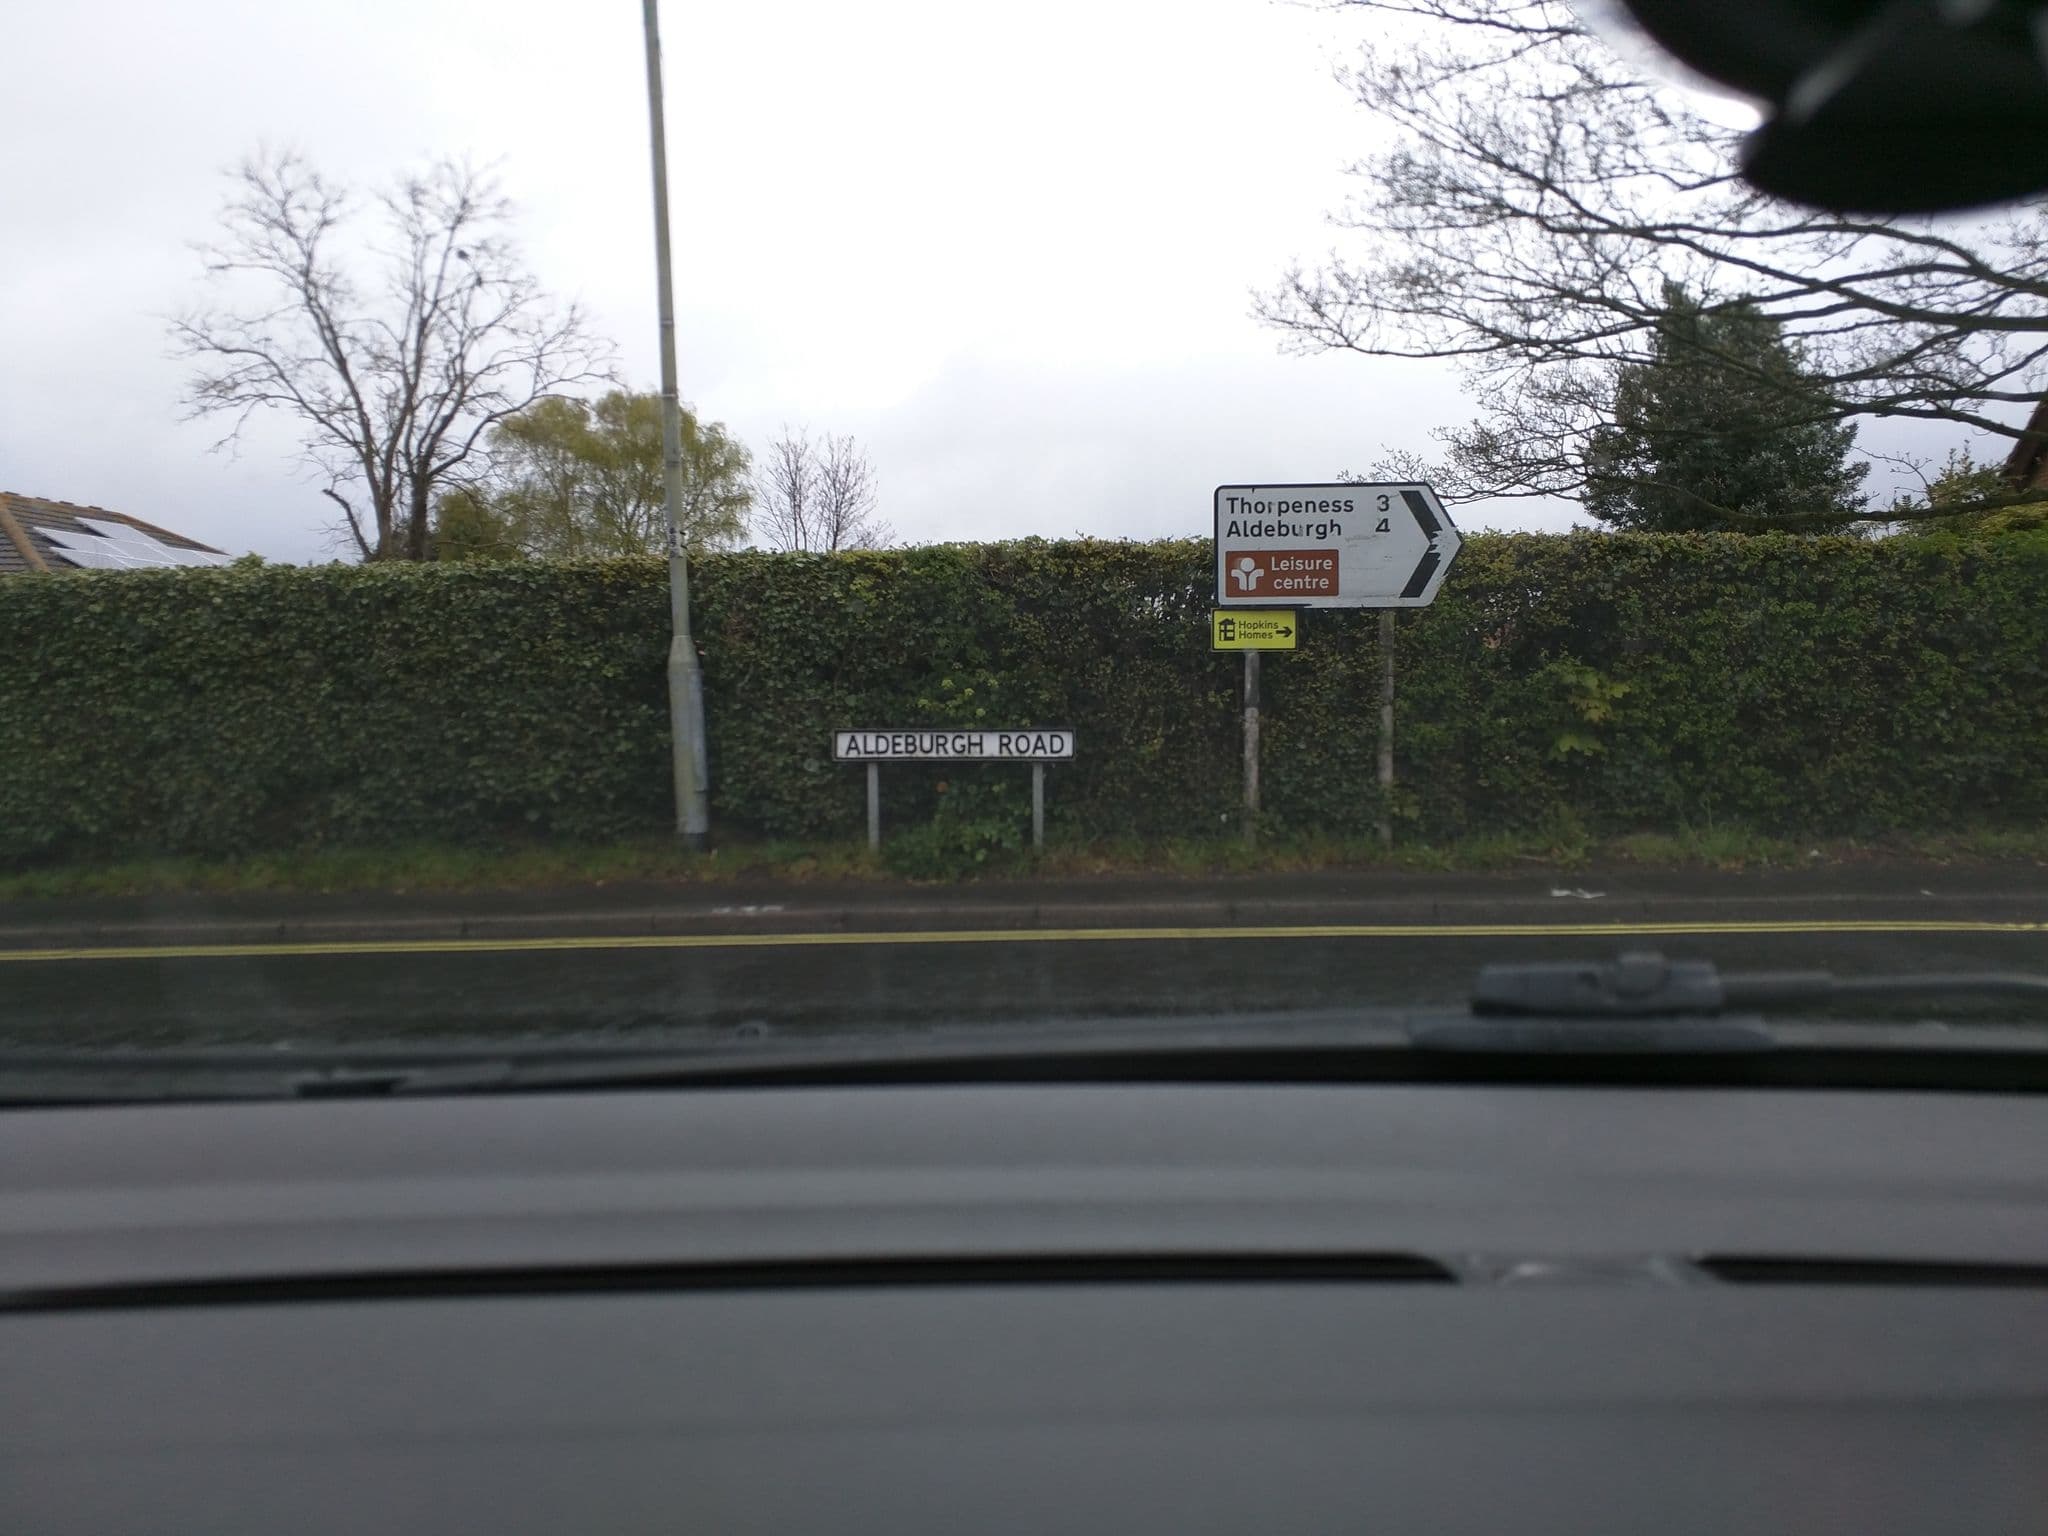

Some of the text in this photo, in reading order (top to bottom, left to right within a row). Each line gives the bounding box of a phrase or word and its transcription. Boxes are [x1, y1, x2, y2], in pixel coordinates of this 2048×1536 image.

[1226, 494, 1390, 517] Thorpeness 3
[1226, 518, 1391, 540] Aldeburgh 4
[1271, 556, 1333, 571] Leisure
[1273, 575, 1330, 590] centre
[1238, 620, 1279, 630] Hopkins
[1238, 630, 1273, 640] Homes
[846, 734, 1065, 755] ALDEBURGH ROAD
